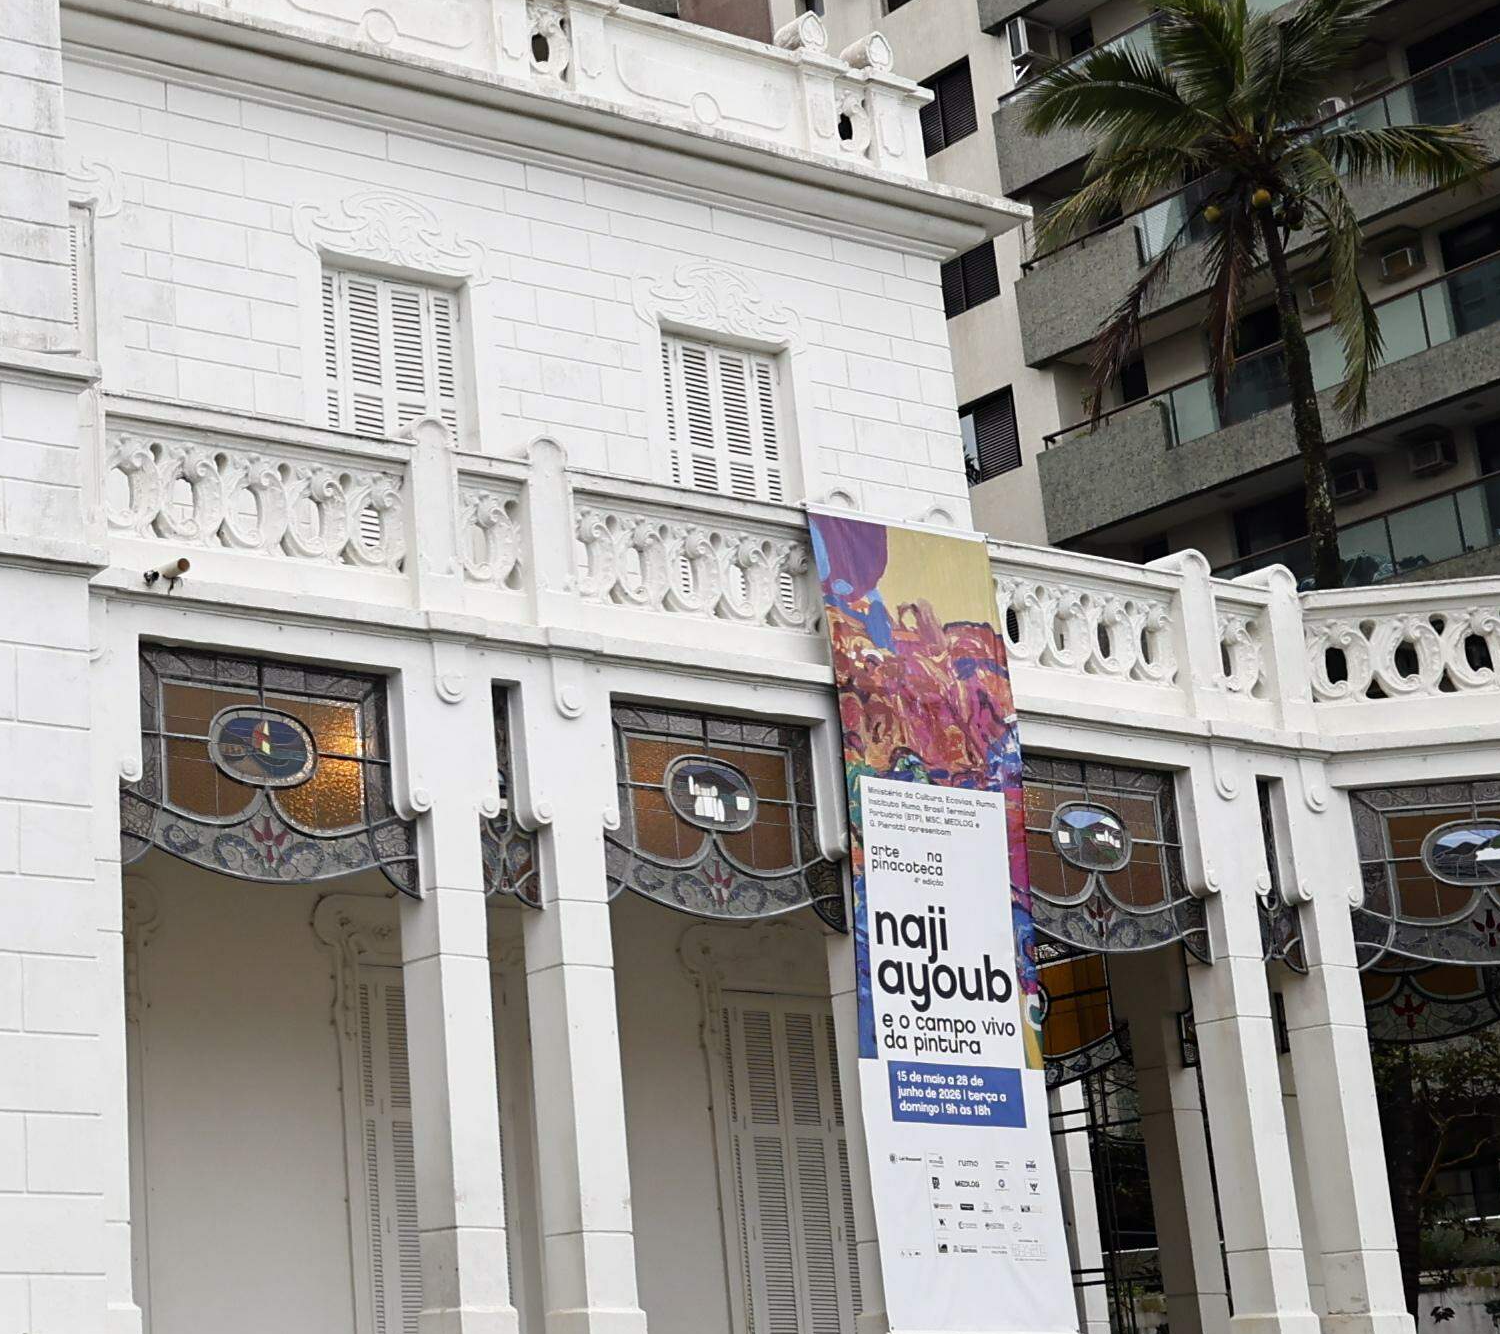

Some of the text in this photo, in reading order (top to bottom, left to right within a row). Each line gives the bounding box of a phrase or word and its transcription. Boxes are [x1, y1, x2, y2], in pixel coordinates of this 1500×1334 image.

[870, 845, 942, 863] arte na
[871, 856, 944, 876] pinacoteca
[875, 905, 948, 964] naji
[877, 954, 1012, 1012] ayoub
[882, 1013, 1015, 1038] e o campo vivo
[884, 1029, 981, 1056] da pintura
[896, 1070, 907, 1082] 15
[909, 1071, 922, 1082] de
[923, 1074, 946, 1085] maio
[947, 1076, 955, 1085] a
[970, 1075, 984, 1087] de
[897, 1086, 924, 1099] junho
[925, 1087, 937, 1099] de
[938, 1088, 962, 1100] 2026
[967, 1090, 998, 1104] terça
[999, 1093, 1007, 1102] a
[899, 1100, 939, 1116] domingo
[946, 1103, 958, 1114] 9h
[960, 1104, 972, 1115] às
[974, 1105, 991, 1116] 18h
